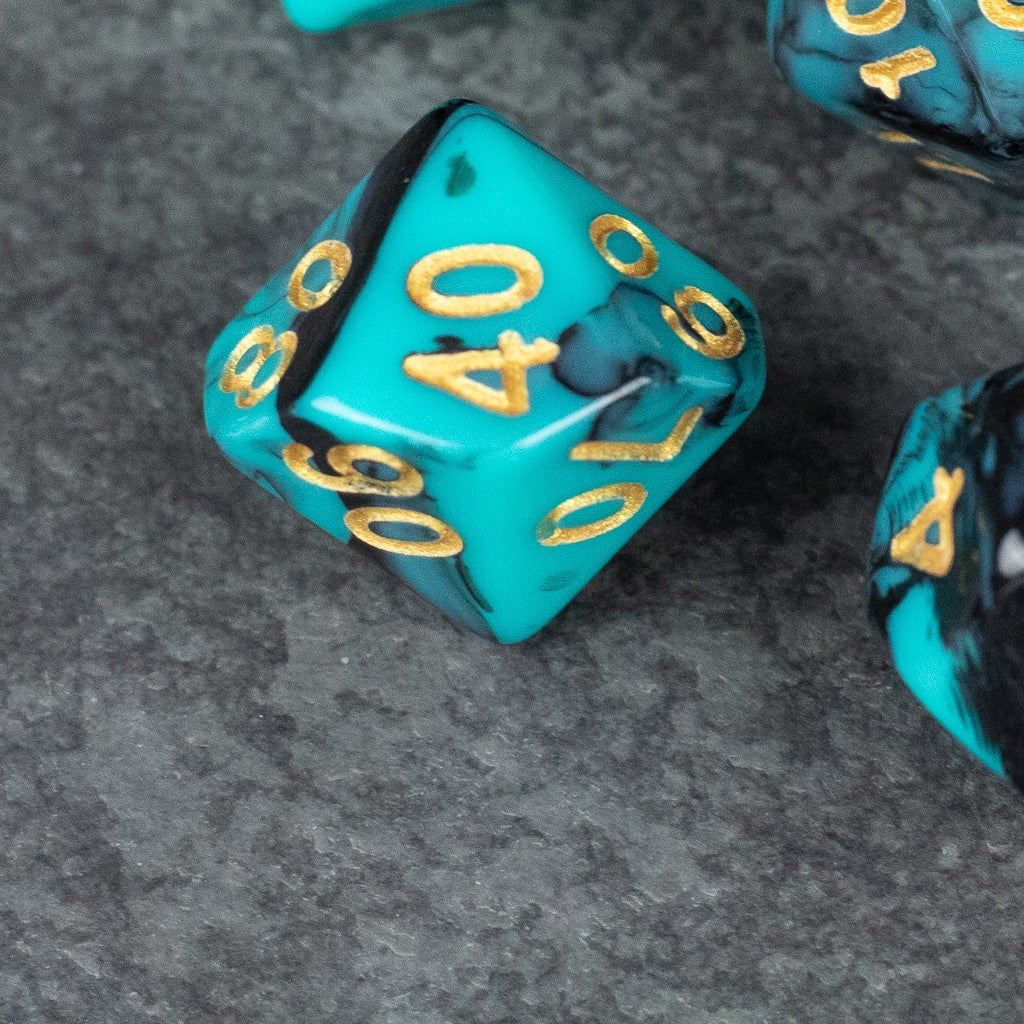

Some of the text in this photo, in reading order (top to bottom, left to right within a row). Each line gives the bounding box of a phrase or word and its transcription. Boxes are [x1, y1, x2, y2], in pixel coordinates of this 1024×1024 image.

[220, 240, 352, 408] 80
[403, 243, 560, 417] 40
[536, 406, 703, 547] 70
[891, 466, 964, 577] 4
